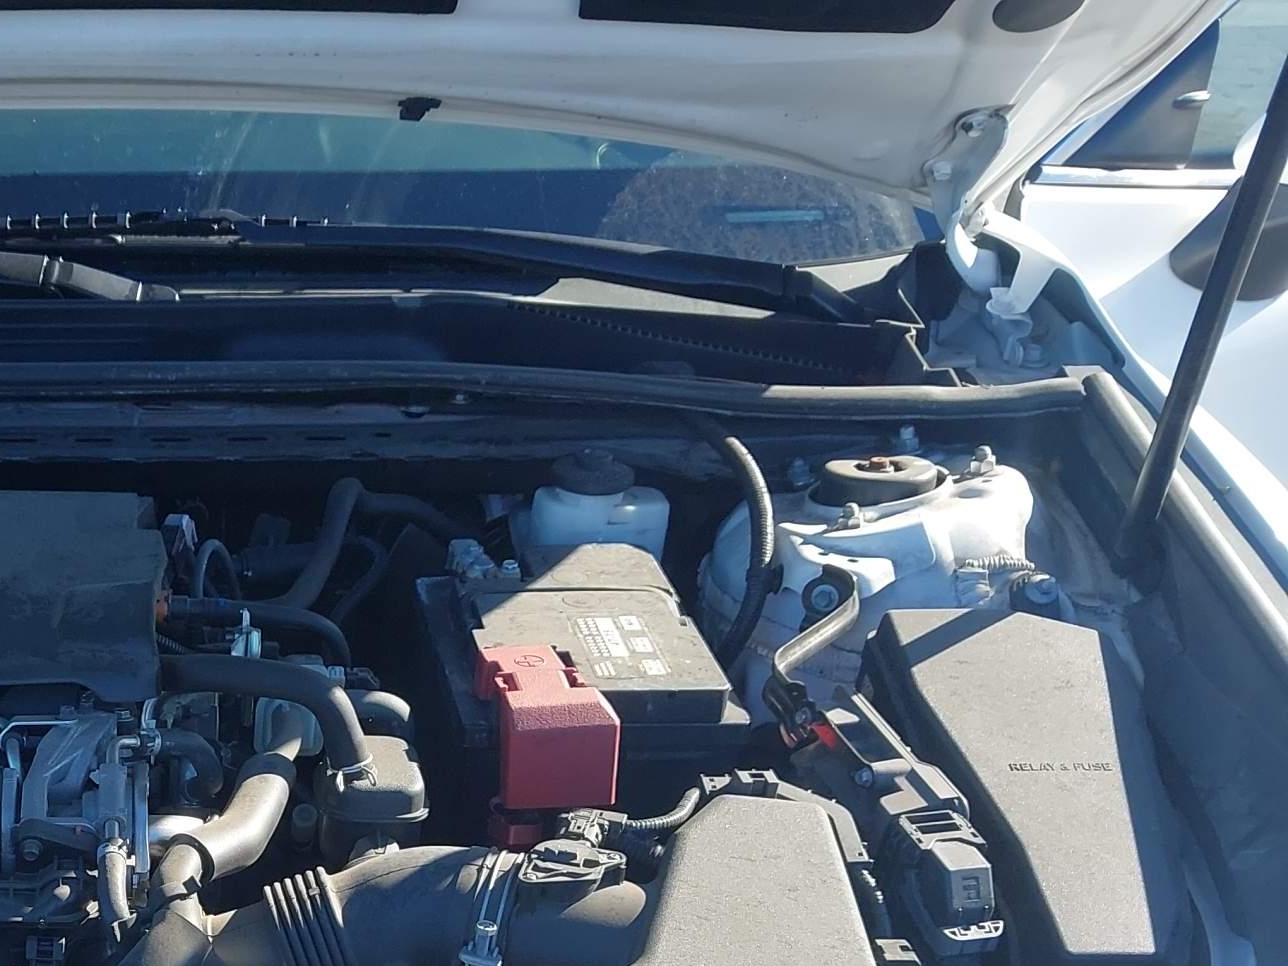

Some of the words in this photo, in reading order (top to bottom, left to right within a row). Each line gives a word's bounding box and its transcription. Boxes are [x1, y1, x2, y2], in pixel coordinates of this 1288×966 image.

[1008, 762, 1056, 772] RELAY
[1059, 762, 1071, 772] &
[1072, 762, 1113, 772] FUSE
